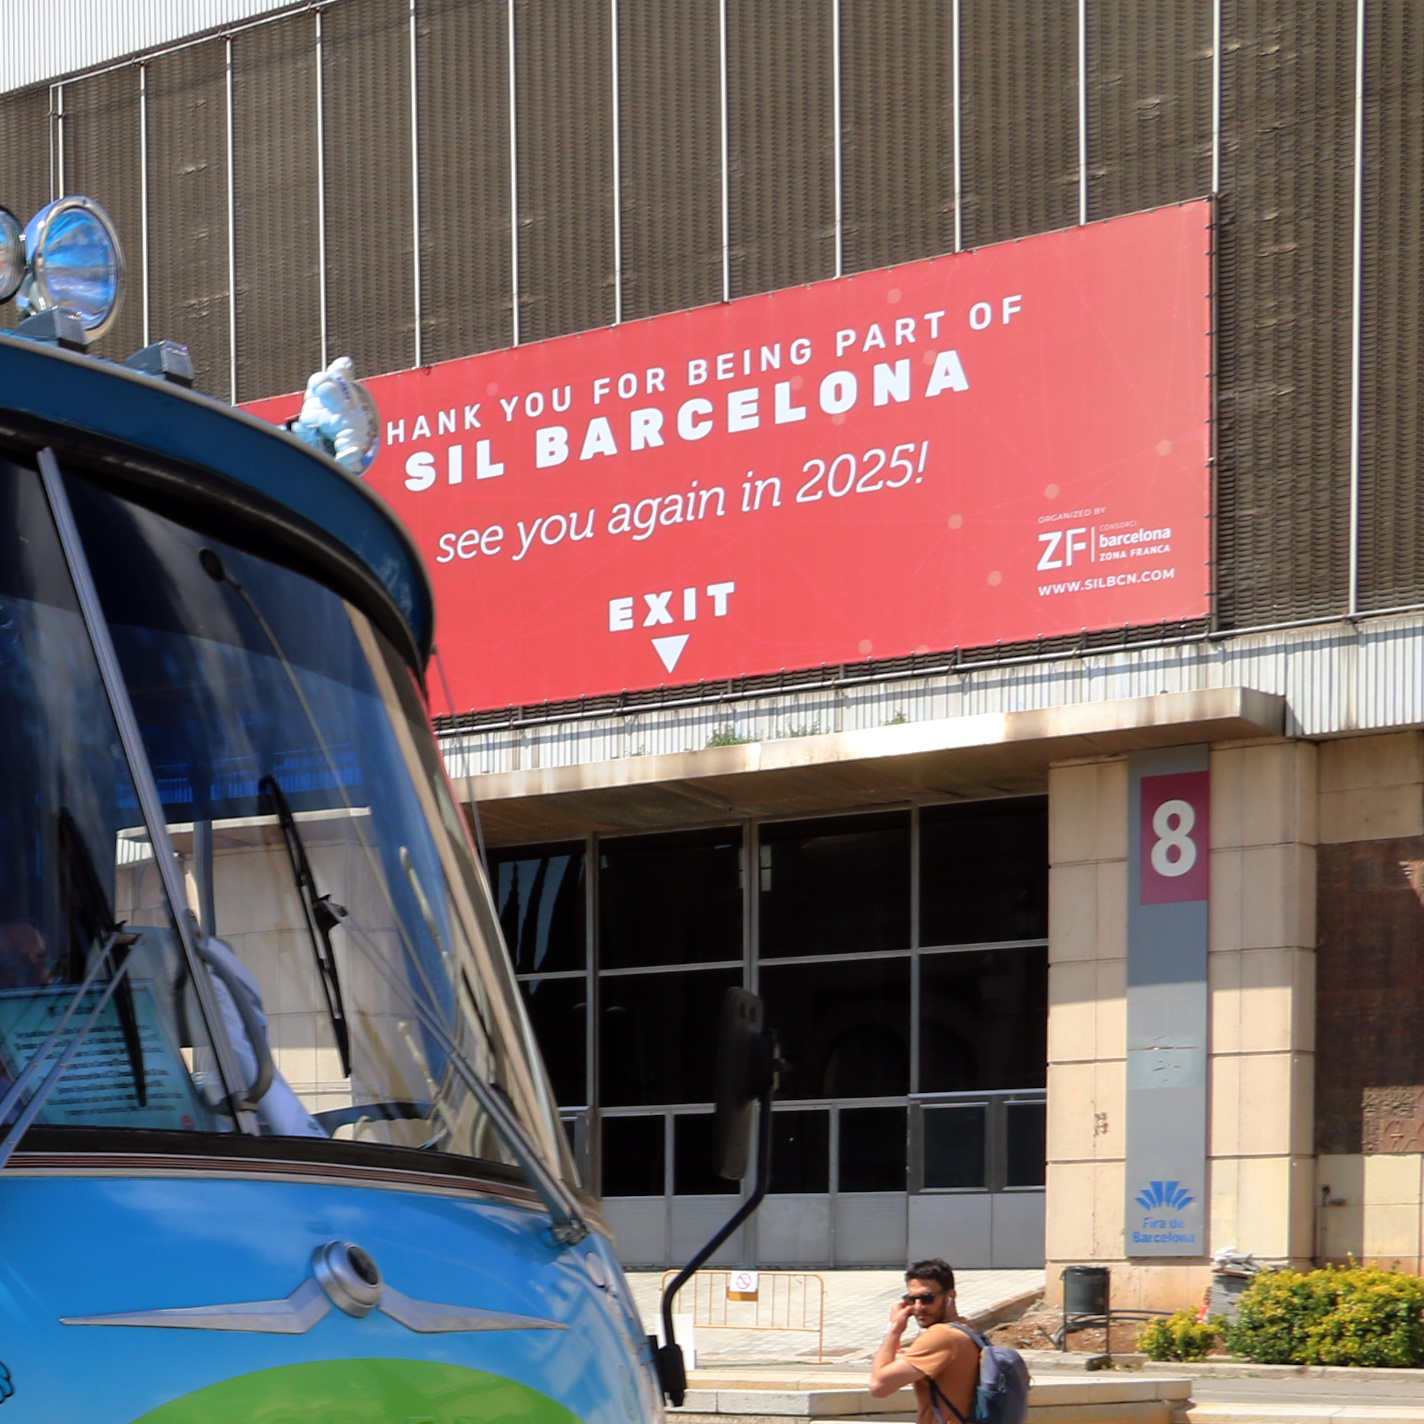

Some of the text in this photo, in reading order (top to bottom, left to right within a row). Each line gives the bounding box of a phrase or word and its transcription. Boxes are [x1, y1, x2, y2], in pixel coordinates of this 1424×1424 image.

[386, 294, 1022, 446] HANK YOU FOR BEING PART OF
[404, 349, 970, 492] SIL BARCELONA
[436, 440, 929, 563] see you again in 2025!
[1037, 506, 1107, 524] ORGANIZED BY
[1036, 527, 1087, 571] ZF
[1098, 544, 1172, 562] ZONA FRANCA
[1099, 527, 1172, 548] barcelona
[1037, 568, 1176, 597] WWW.SILBCN.COM
[608, 581, 735, 632] EXIT
[1150, 799, 1197, 878] 8
[1133, 1231, 1195, 1243] Barcelona
[1142, 1217, 1185, 1229] Fira de
